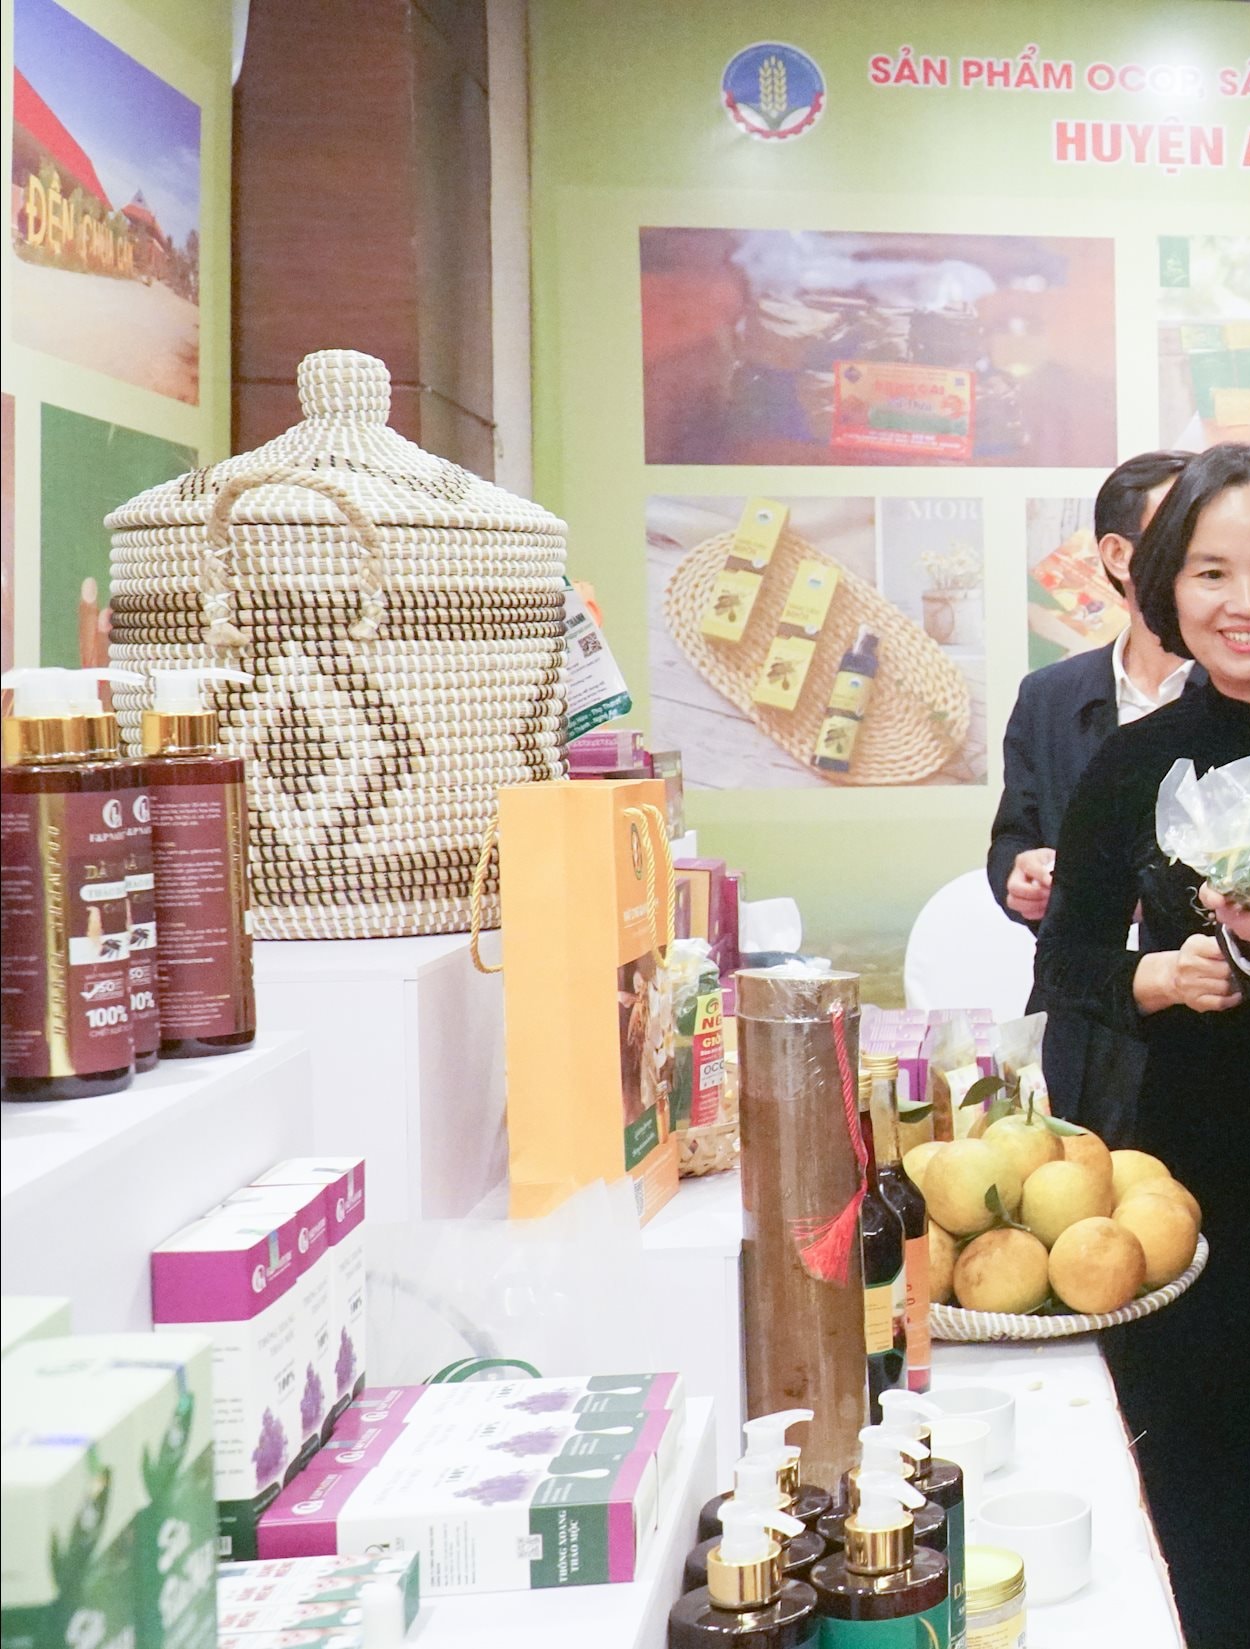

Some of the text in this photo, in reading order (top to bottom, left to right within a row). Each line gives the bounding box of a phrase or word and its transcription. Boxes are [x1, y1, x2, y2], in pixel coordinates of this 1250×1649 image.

[869, 46, 948, 86] SẢN
[961, 44, 1074, 91] PHẨM
[1055, 116, 1224, 175] HUYỆN
[85, 1004, 129, 1029] 100%
